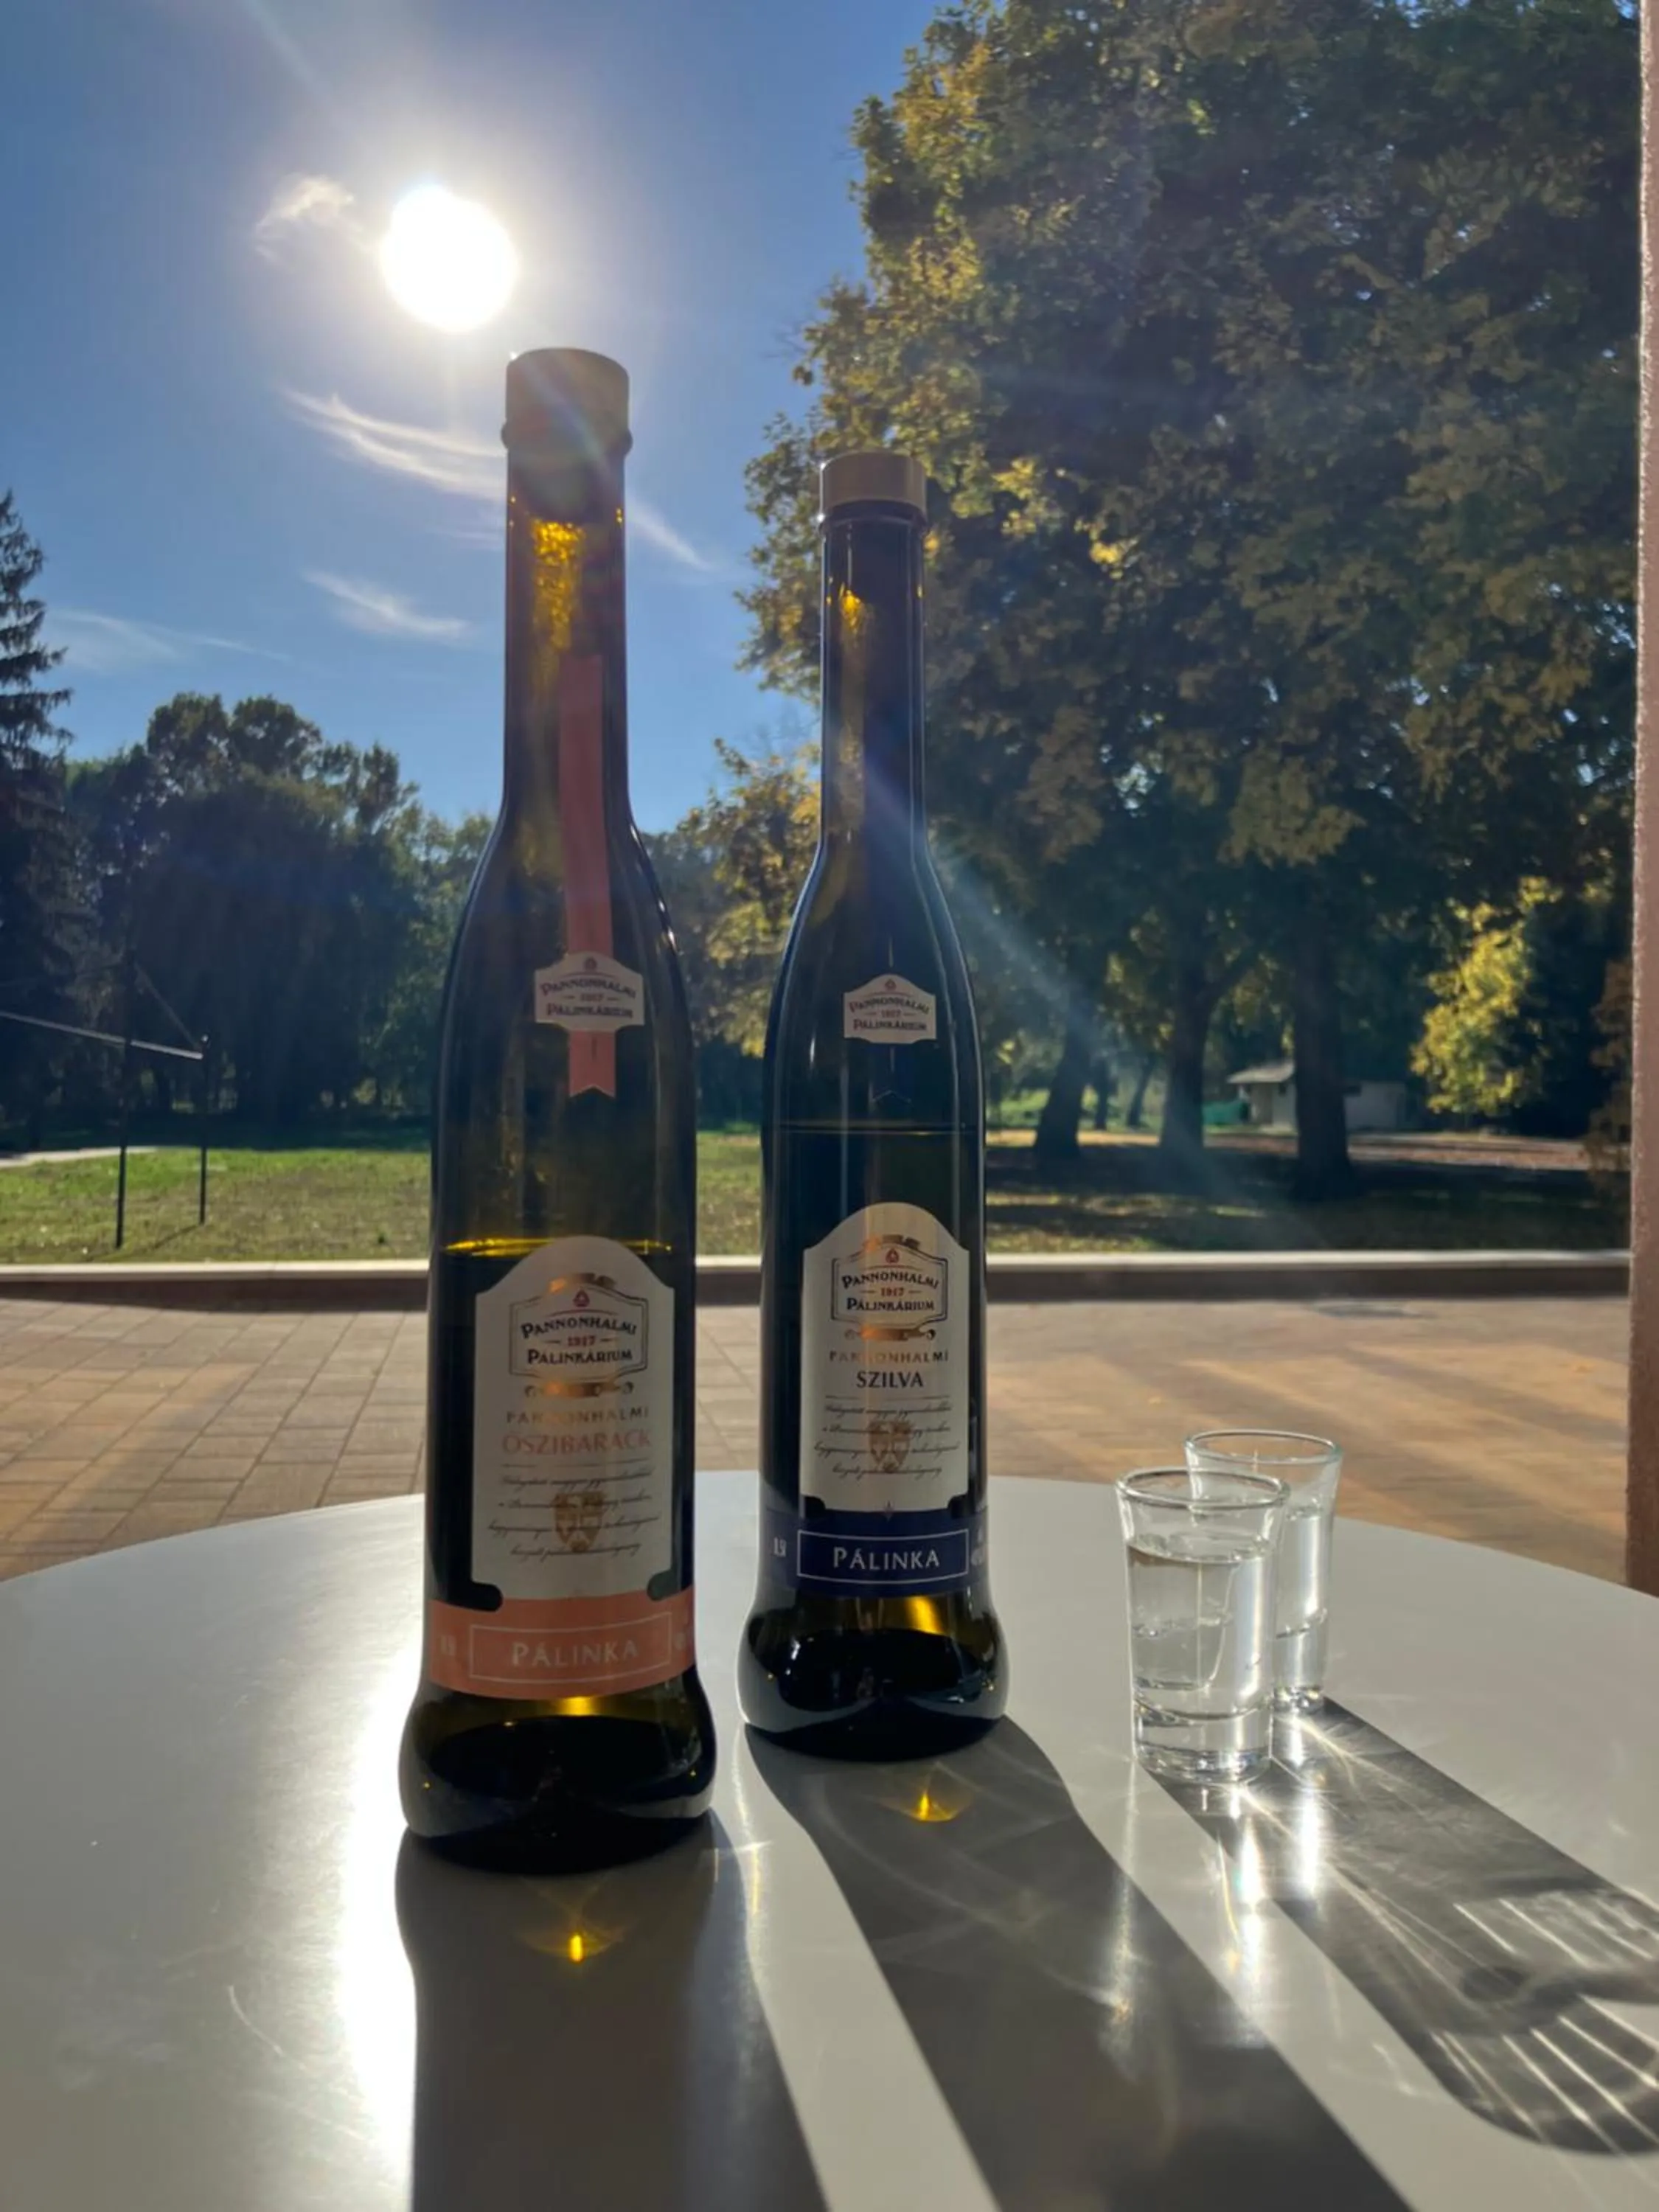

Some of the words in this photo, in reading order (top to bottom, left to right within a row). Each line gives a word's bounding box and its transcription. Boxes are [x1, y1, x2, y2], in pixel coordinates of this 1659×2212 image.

[841, 1271, 939, 1290] PANNONHALMI
[521, 1316, 636, 1339] PANNONHALMI
[829, 1350, 949, 1363] PANONHALMI
[856, 1371, 924, 1389] SZILVA
[506, 1405, 649, 1424] PANNHALMI
[832, 1545, 941, 1571] PÁLINKA
[510, 1639, 639, 1668] PÁLINKA
